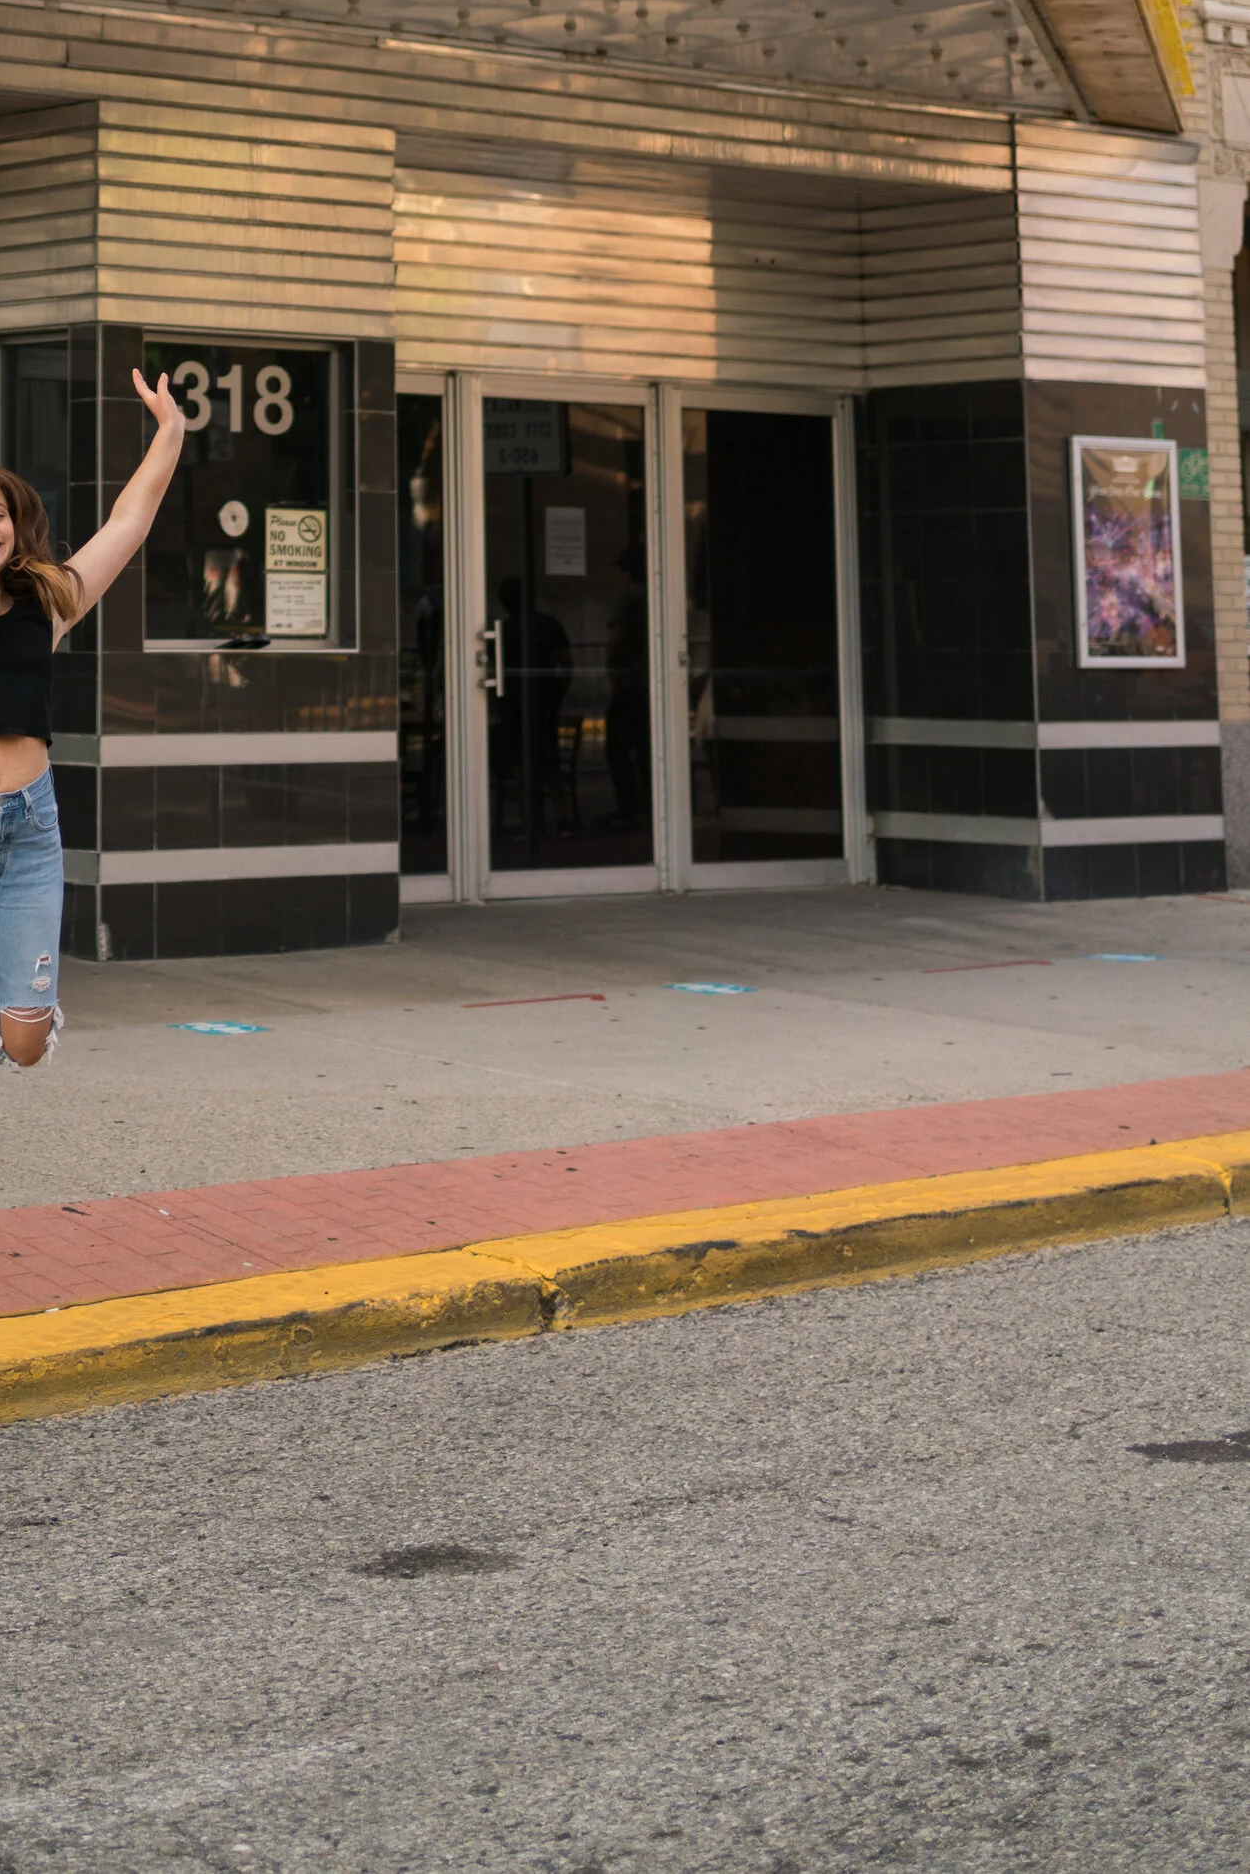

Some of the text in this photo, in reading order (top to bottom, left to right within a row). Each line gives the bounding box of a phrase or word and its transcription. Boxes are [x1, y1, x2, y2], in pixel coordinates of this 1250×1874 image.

[172, 360, 294, 436] 318
[270, 530, 286, 542] NO
[270, 544, 322, 558] SMOKING
